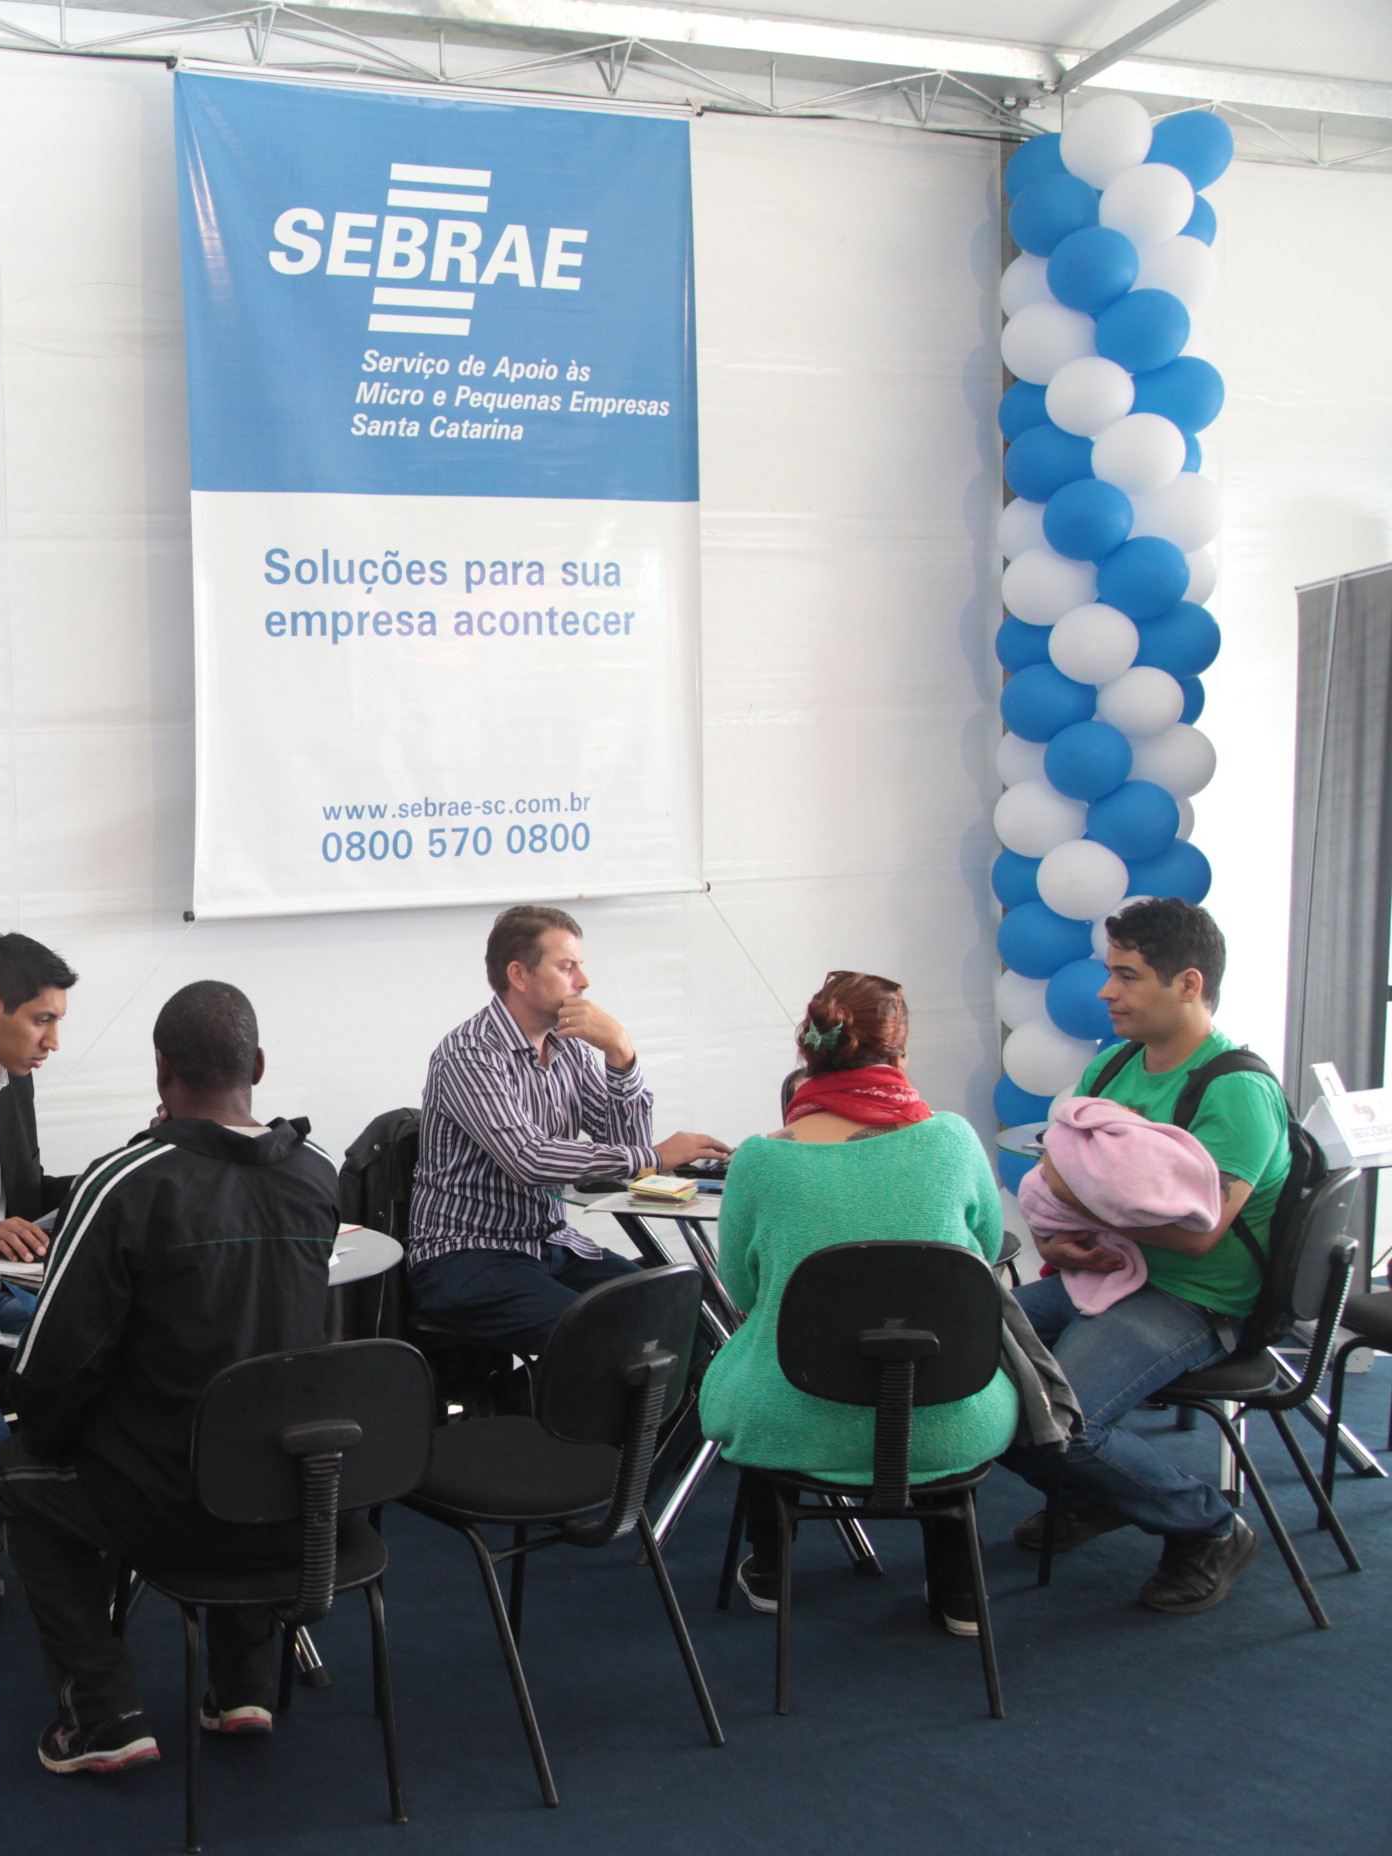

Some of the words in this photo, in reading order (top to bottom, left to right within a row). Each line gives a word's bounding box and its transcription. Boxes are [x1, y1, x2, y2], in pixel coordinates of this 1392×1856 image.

[268, 207, 588, 290] SEBRAE
[361, 349, 449, 379] Serviço
[458, 354, 485, 377] de
[493, 356, 558, 383] Apoio
[566, 360, 590, 382] às
[355, 381, 424, 407] Micro
[433, 388, 446, 407] e
[454, 386, 562, 415] Pequenas
[569, 391, 670, 418] Empresas
[351, 414, 420, 438] Santa
[429, 416, 524, 441] Catarina
[264, 547, 448, 594] Soluções
[464, 558, 545, 594] para
[560, 560, 621, 587] sua
[264, 610, 437, 645] empresa
[453, 605, 635, 637] acontecer
[322, 792, 591, 821] www.sebrae-sc.com.br
[321, 829, 413, 863] 0800
[428, 826, 492, 858] 570
[507, 822, 590, 854] 0800
[1324, 1075, 1342, 1097] 1
